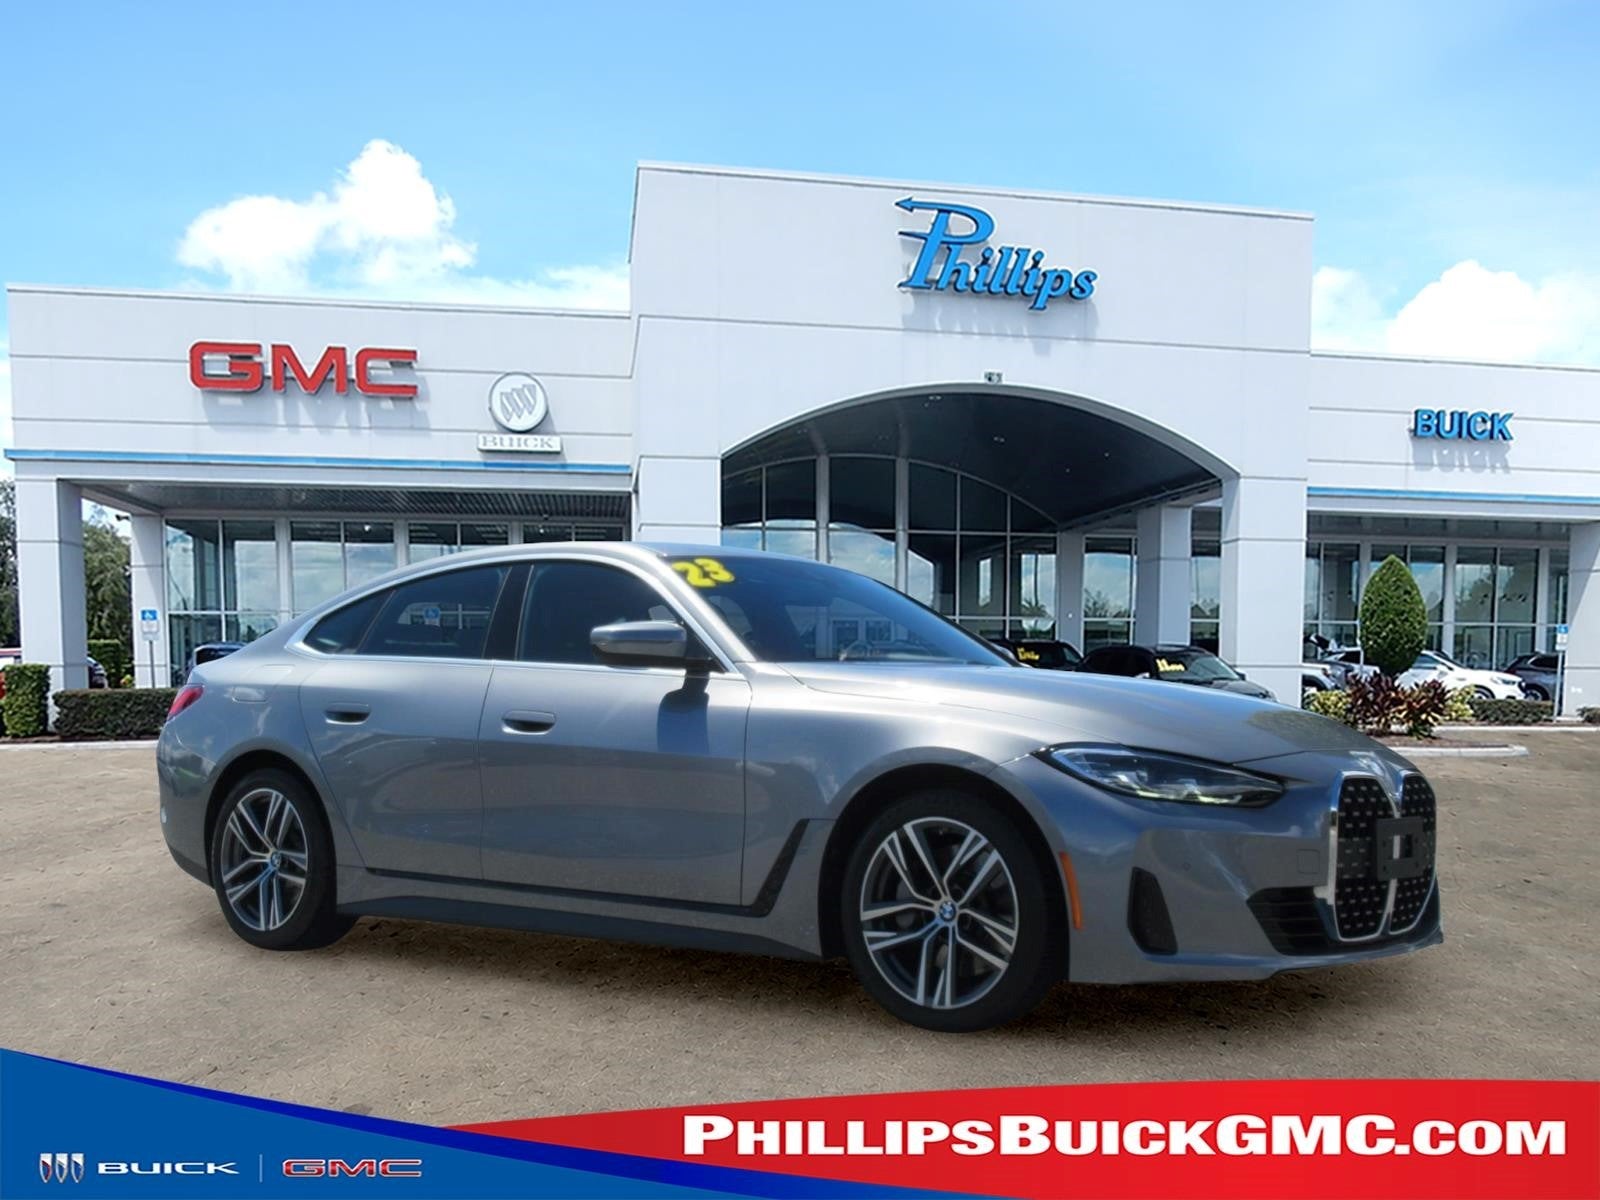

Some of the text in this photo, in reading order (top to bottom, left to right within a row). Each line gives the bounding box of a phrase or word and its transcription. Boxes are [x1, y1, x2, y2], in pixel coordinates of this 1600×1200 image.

[895, 197, 1098, 310] Phillips
[189, 341, 418, 397] GMC
[1414, 408, 1513, 441] BUICK
[482, 435, 554, 449] BUICK
[671, 557, 735, 588] 23
